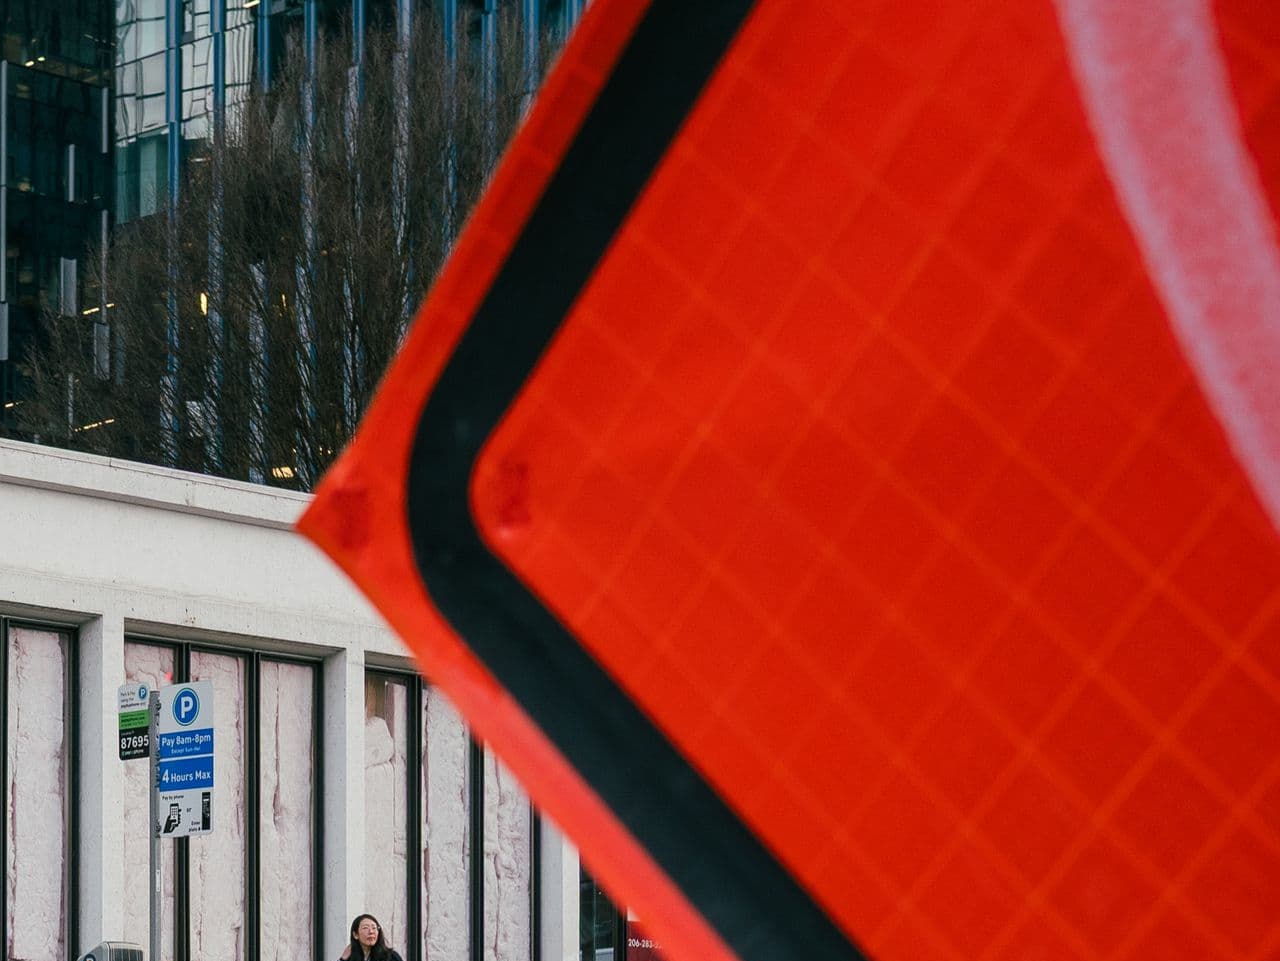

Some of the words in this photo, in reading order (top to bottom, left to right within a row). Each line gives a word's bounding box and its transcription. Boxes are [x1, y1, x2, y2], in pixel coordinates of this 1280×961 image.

[180, 696, 194, 719] P
[120, 734, 149, 750] 87695
[161, 737, 175, 747] Pay
[176, 734, 211, 745] 8am-8pm
[162, 768, 170, 784] 4
[171, 772, 194, 783] Hours
[195, 769, 211, 780] Max
